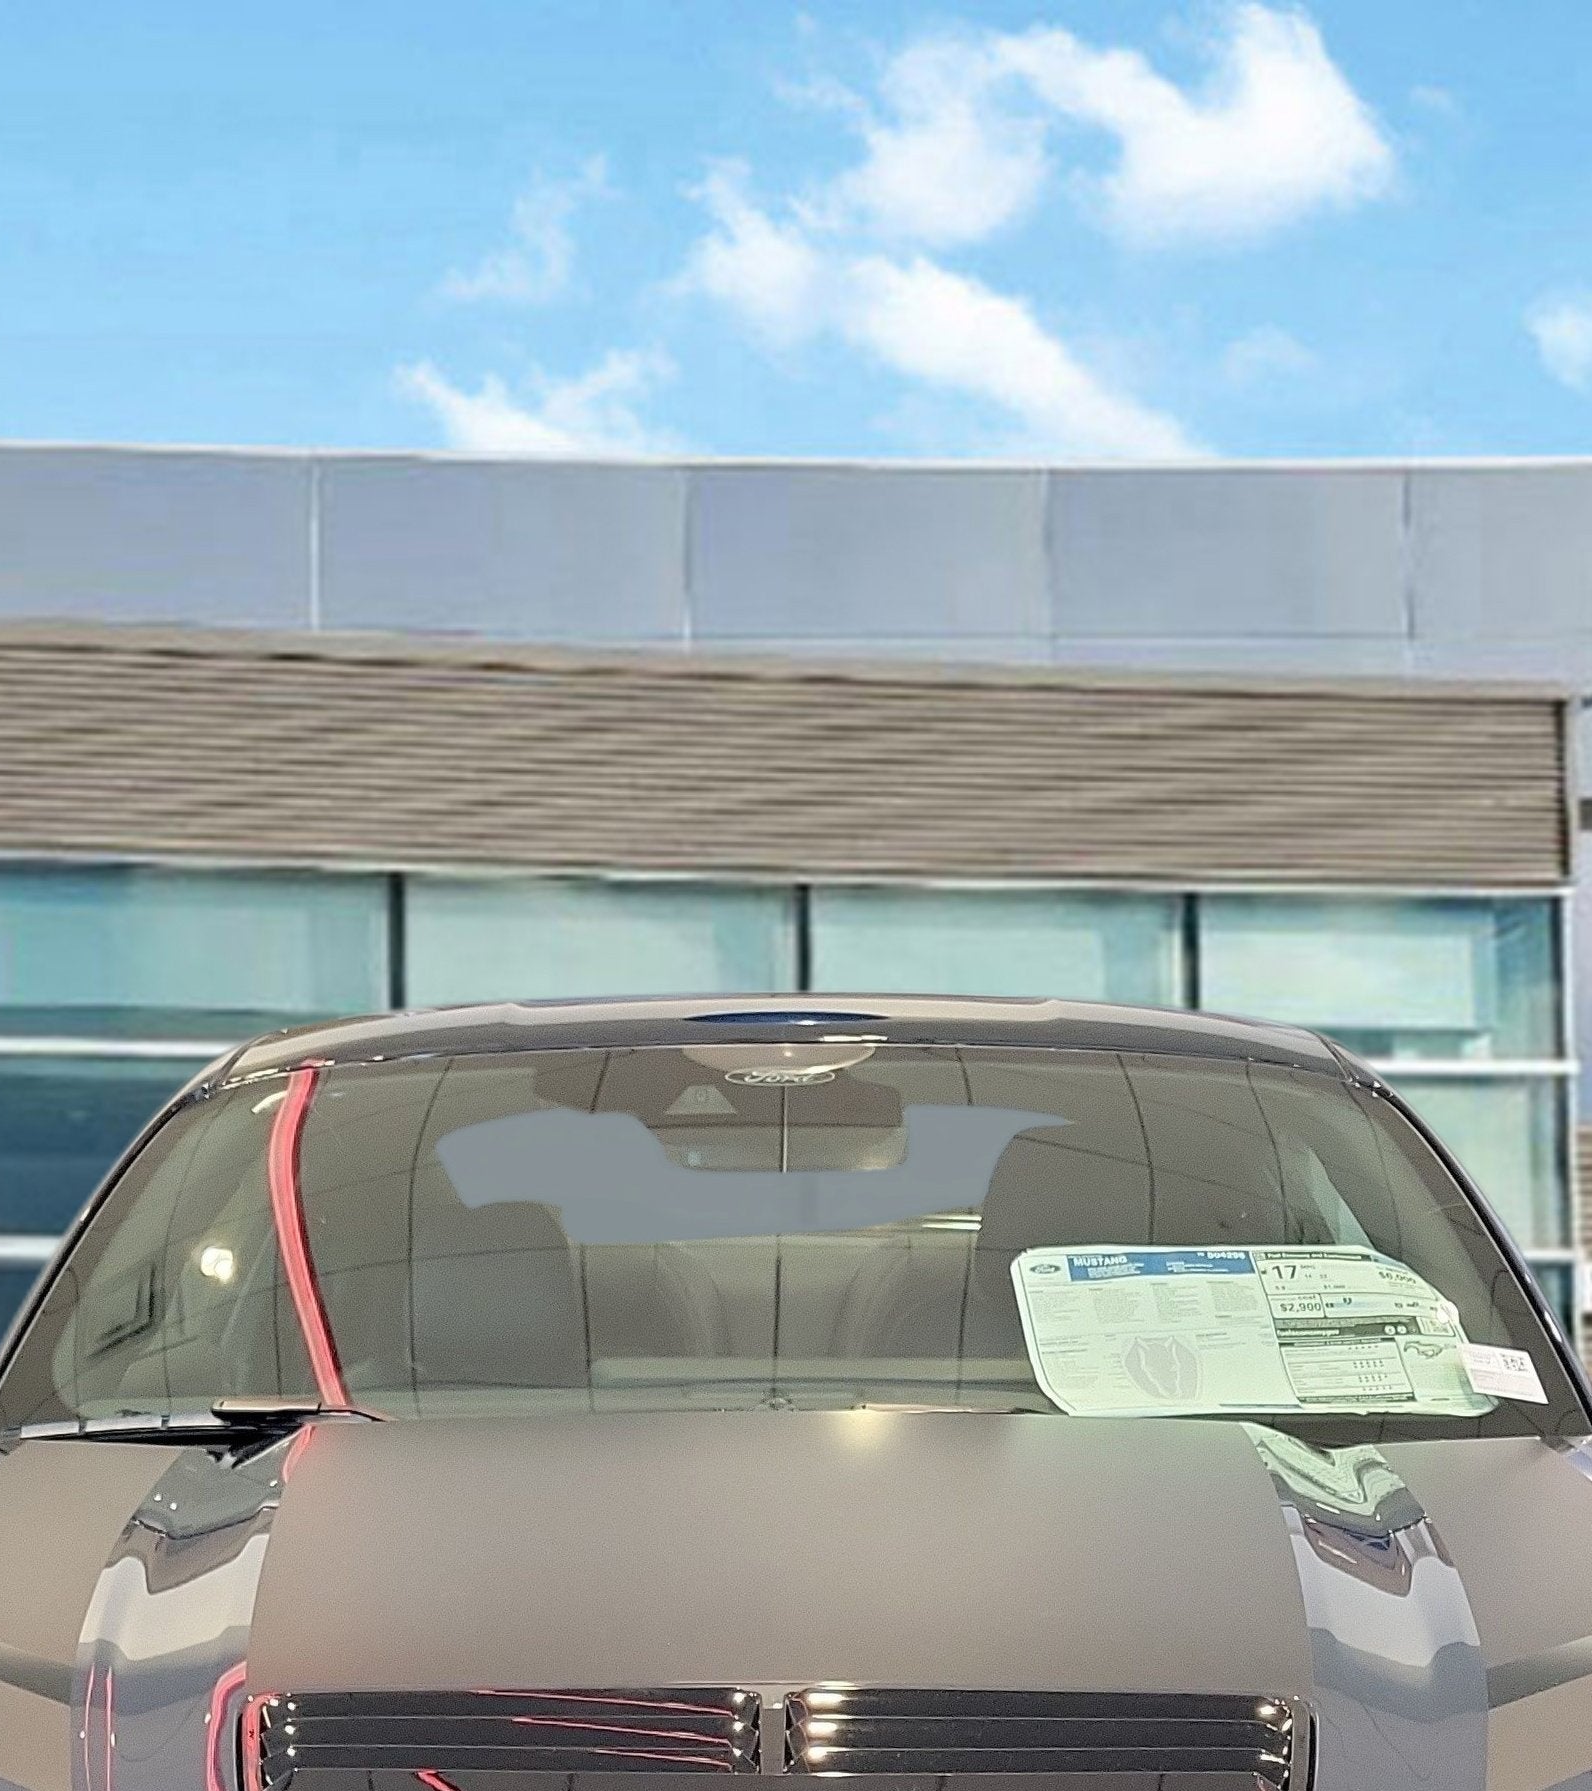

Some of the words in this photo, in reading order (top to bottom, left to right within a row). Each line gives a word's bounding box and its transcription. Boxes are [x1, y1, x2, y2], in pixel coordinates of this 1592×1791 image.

[1073, 1255, 1127, 1266] MUSTANG
[1272, 1265, 1297, 1279] 17
[1280, 1302, 1321, 1313] $2,900
